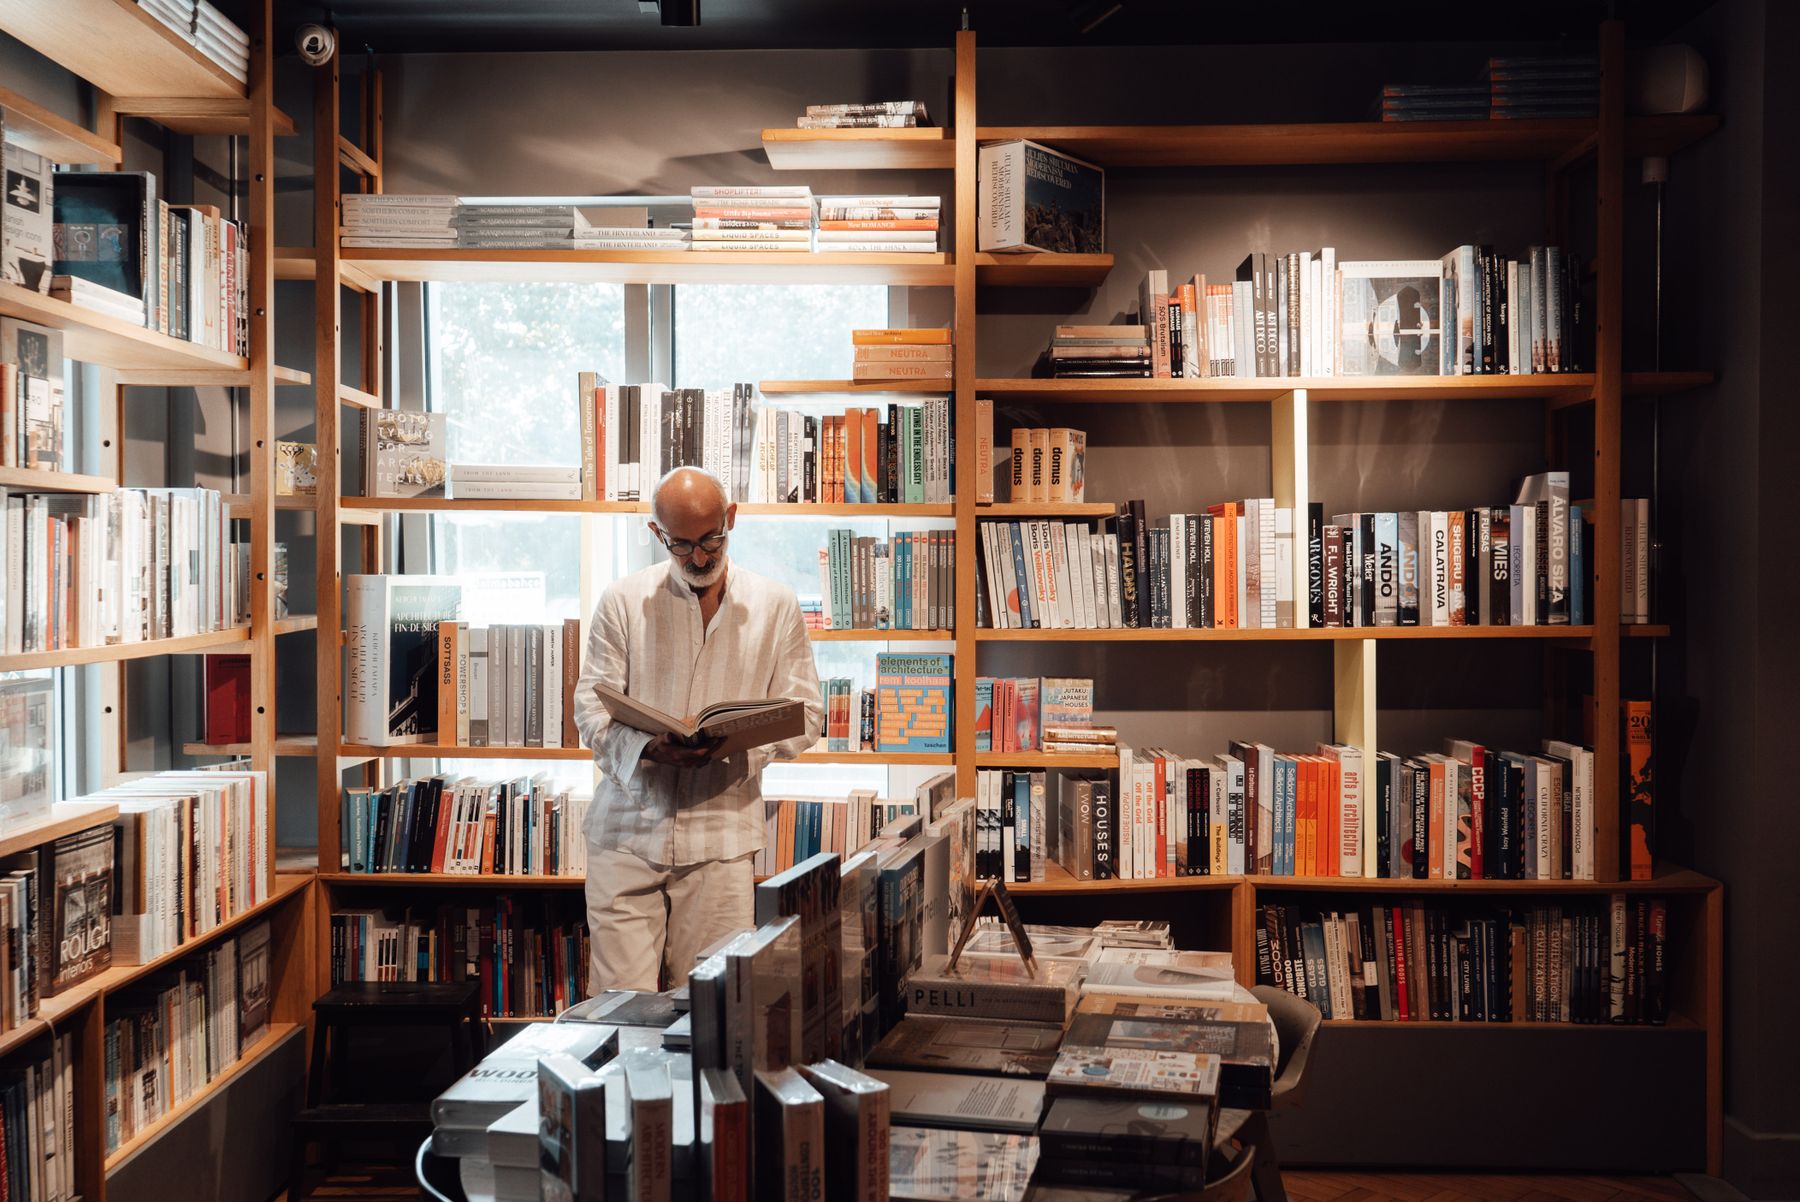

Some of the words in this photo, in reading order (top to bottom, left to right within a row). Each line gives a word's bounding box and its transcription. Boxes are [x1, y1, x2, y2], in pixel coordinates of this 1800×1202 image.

[1256, 310, 1264, 324] ART
[1268, 310, 1276, 324] ART
[890, 349, 928, 358] NEUTRA
[889, 367, 926, 376] NEUTRA
[584, 396, 593, 436] Tomorrow
[722, 391, 730, 452] ELEMENTAL
[912, 408, 922, 429] LIVING
[378, 442, 406, 453] FOR
[584, 436, 593, 444] of
[584, 444, 593, 461] Tale
[912, 436, 922, 447] THE
[584, 463, 593, 478] The
[912, 448, 922, 472] ENDLESS
[980, 438, 988, 475] NEUTRA
[1014, 448, 1024, 486] domus
[1032, 448, 1043, 486] domus
[1052, 447, 1062, 485] domus
[377, 474, 423, 484] TECTS
[722, 455, 730, 489] LIVING
[912, 472, 922, 485] CITY
[1481, 518, 1489, 552] FUKSAS
[1552, 496, 1566, 560] ÁLVARO
[1453, 525, 1462, 579] SHIGERU
[1494, 540, 1508, 580] MIES
[1513, 546, 1521, 586] LEGORRETA
[1624, 526, 1632, 594] REDISCOVERED
[878, 560, 887, 604] Architecture
[1034, 550, 1046, 602] Velikovsky
[1046, 550, 1056, 602] Velikovsky
[1095, 565, 1104, 582] ZAHA
[1108, 565, 1118, 582] ZAHA
[1310, 536, 1324, 604] ARAGONÉS
[1364, 554, 1375, 582] Meier
[1380, 542, 1392, 598] ANDO
[1404, 543, 1414, 597] ANDO
[1436, 530, 1446, 608] CALATRAVA
[1096, 584, 1104, 604] HADID
[1110, 584, 1118, 604] HADID
[1328, 567, 1338, 614] WRIGHT
[1453, 584, 1462, 608] BAN
[1552, 564, 1564, 602] SIZA
[880, 656, 928, 666] elements
[930, 656, 941, 666] of
[880, 665, 944, 674] architecture
[1630, 716, 1650, 728] 20
[1216, 779, 1222, 787] Le
[1236, 775, 1244, 787] LE
[1276, 768, 1285, 796] Selldorf
[1287, 768, 1296, 796] Selldorf
[1344, 772, 1360, 788] arts
[1472, 766, 1485, 800] CCCP
[1080, 794, 1090, 824] WOW
[1229, 792, 1236, 804] LE
[1541, 787, 1549, 832] CALIFORNIA
[1096, 795, 1108, 862] HOUSES
[1275, 797, 1284, 833] Architects
[1286, 797, 1295, 833] Architects
[1501, 808, 1509, 836] Weinfeld
[1344, 804, 1360, 856] architecture
[1501, 836, 1509, 850] Isay
[1541, 834, 1549, 860] CRAZY
[60, 921, 110, 963] ROUGH
[1616, 922, 1624, 948] houses
[59, 956, 93, 982] interiors
[1294, 959, 1306, 998] CONCRETE
[1308, 959, 1316, 988] GLASS
[1318, 958, 1326, 987] GLASS
[1536, 930, 1545, 1002] CIVILIZATION
[1550, 930, 1560, 1002] CIVILIZATION
[915, 989, 975, 1008] PELLI
[811, 1168, 820, 1200] 100
[868, 1166, 877, 1188] THE
